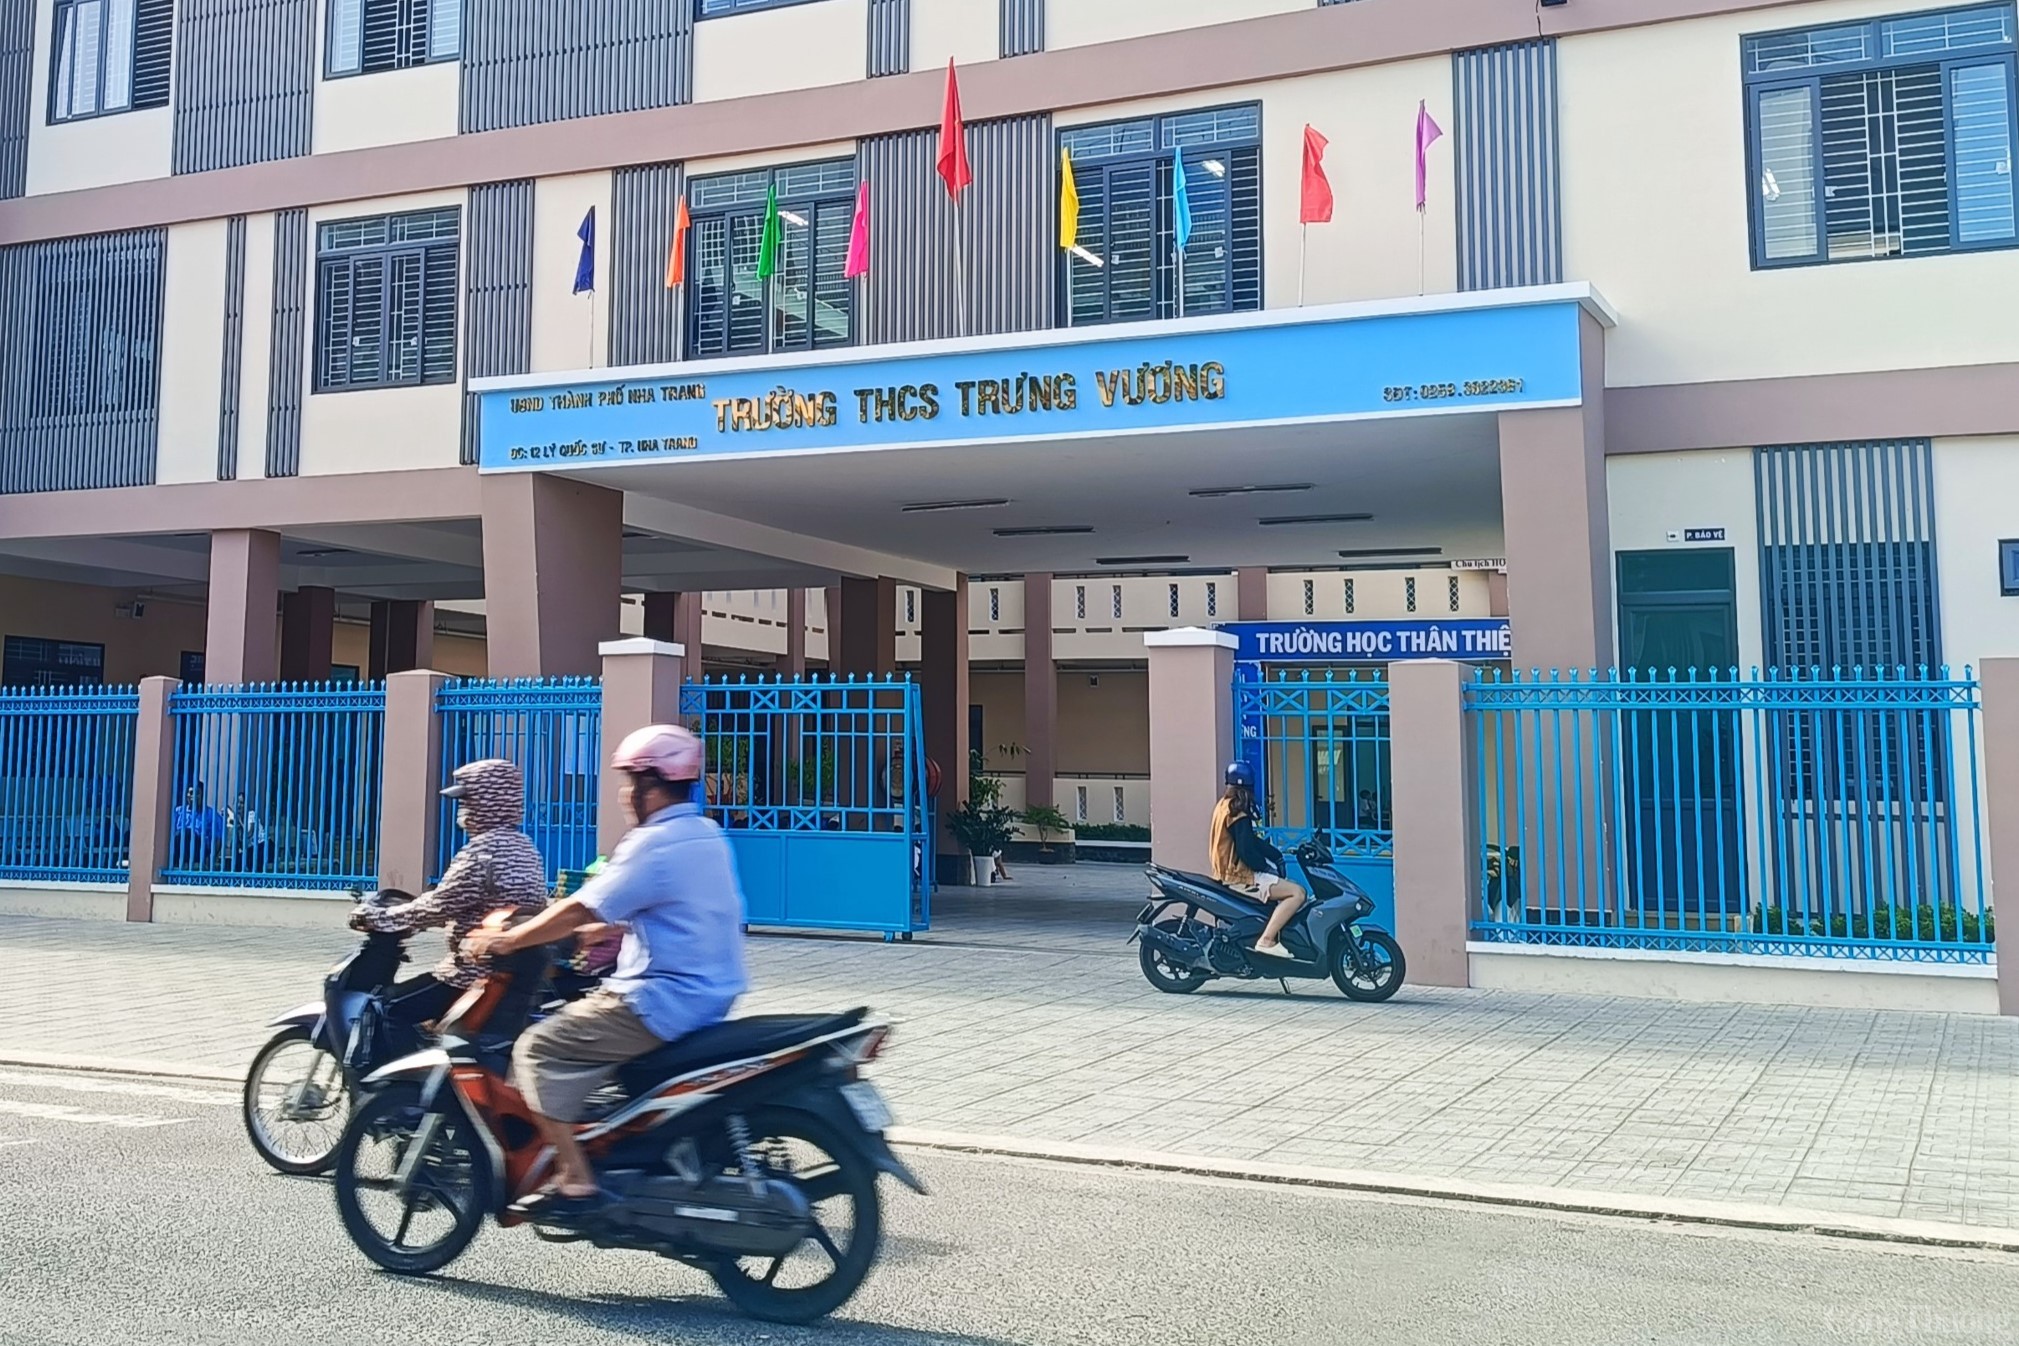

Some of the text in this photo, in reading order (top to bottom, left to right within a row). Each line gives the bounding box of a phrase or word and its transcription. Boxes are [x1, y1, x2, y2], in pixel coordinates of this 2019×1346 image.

[549, 390, 592, 410] THÀNH
[598, 384, 625, 406] PHỐ
[628, 387, 655, 404] NHA
[660, 383, 705, 402] TRANG
[712, 360, 1225, 432] TRƯỜNG THCS TRƯNG VƯƠNG
[1256, 626, 1342, 653] TRƯỜNG
[1347, 632, 1392, 657] HỌC
[1396, 625, 1457, 652] THÂN
